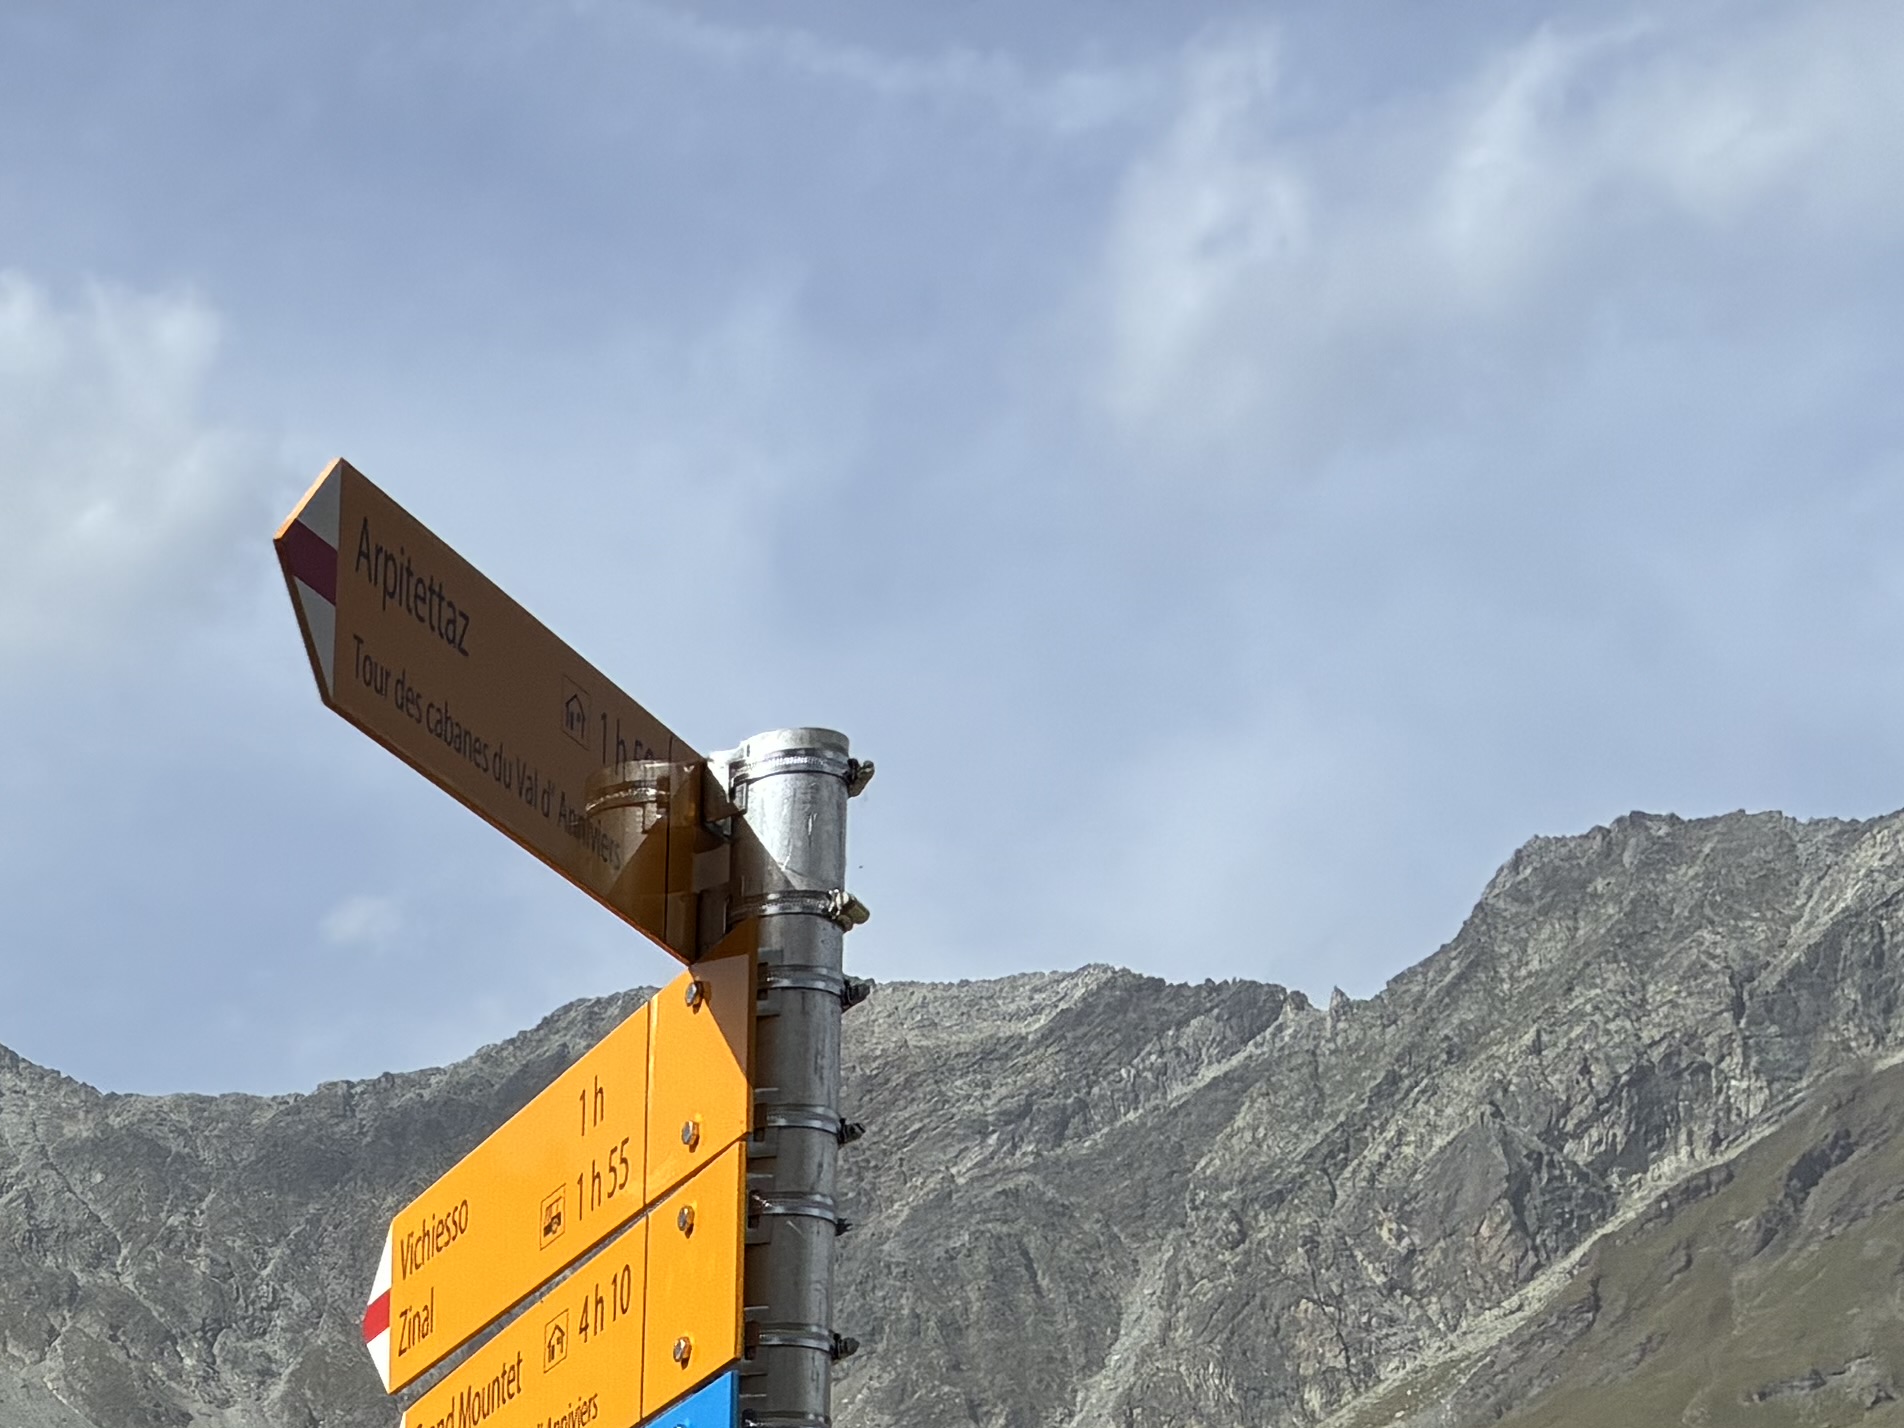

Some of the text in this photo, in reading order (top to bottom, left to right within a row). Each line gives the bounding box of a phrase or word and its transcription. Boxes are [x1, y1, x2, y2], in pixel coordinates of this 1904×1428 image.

[355, 516, 470, 657] Arpitettaz
[353, 633, 391, 699] Tour
[394, 668, 422, 725] des
[426, 700, 489, 773] cabanes
[492, 741, 512, 789] du
[516, 756, 538, 810] Val
[558, 791, 621, 871] Anniviers
[600, 712, 608, 765] 1
[615, 719, 627, 781] h
[397, 1137, 630, 1358] Zinal 1 h 55
[399, 1075, 604, 1280] Vichiesso 1 h
[579, 1295, 589, 1344] 4
[593, 1282, 604, 1337] h
[611, 1264, 631, 1322] 10
